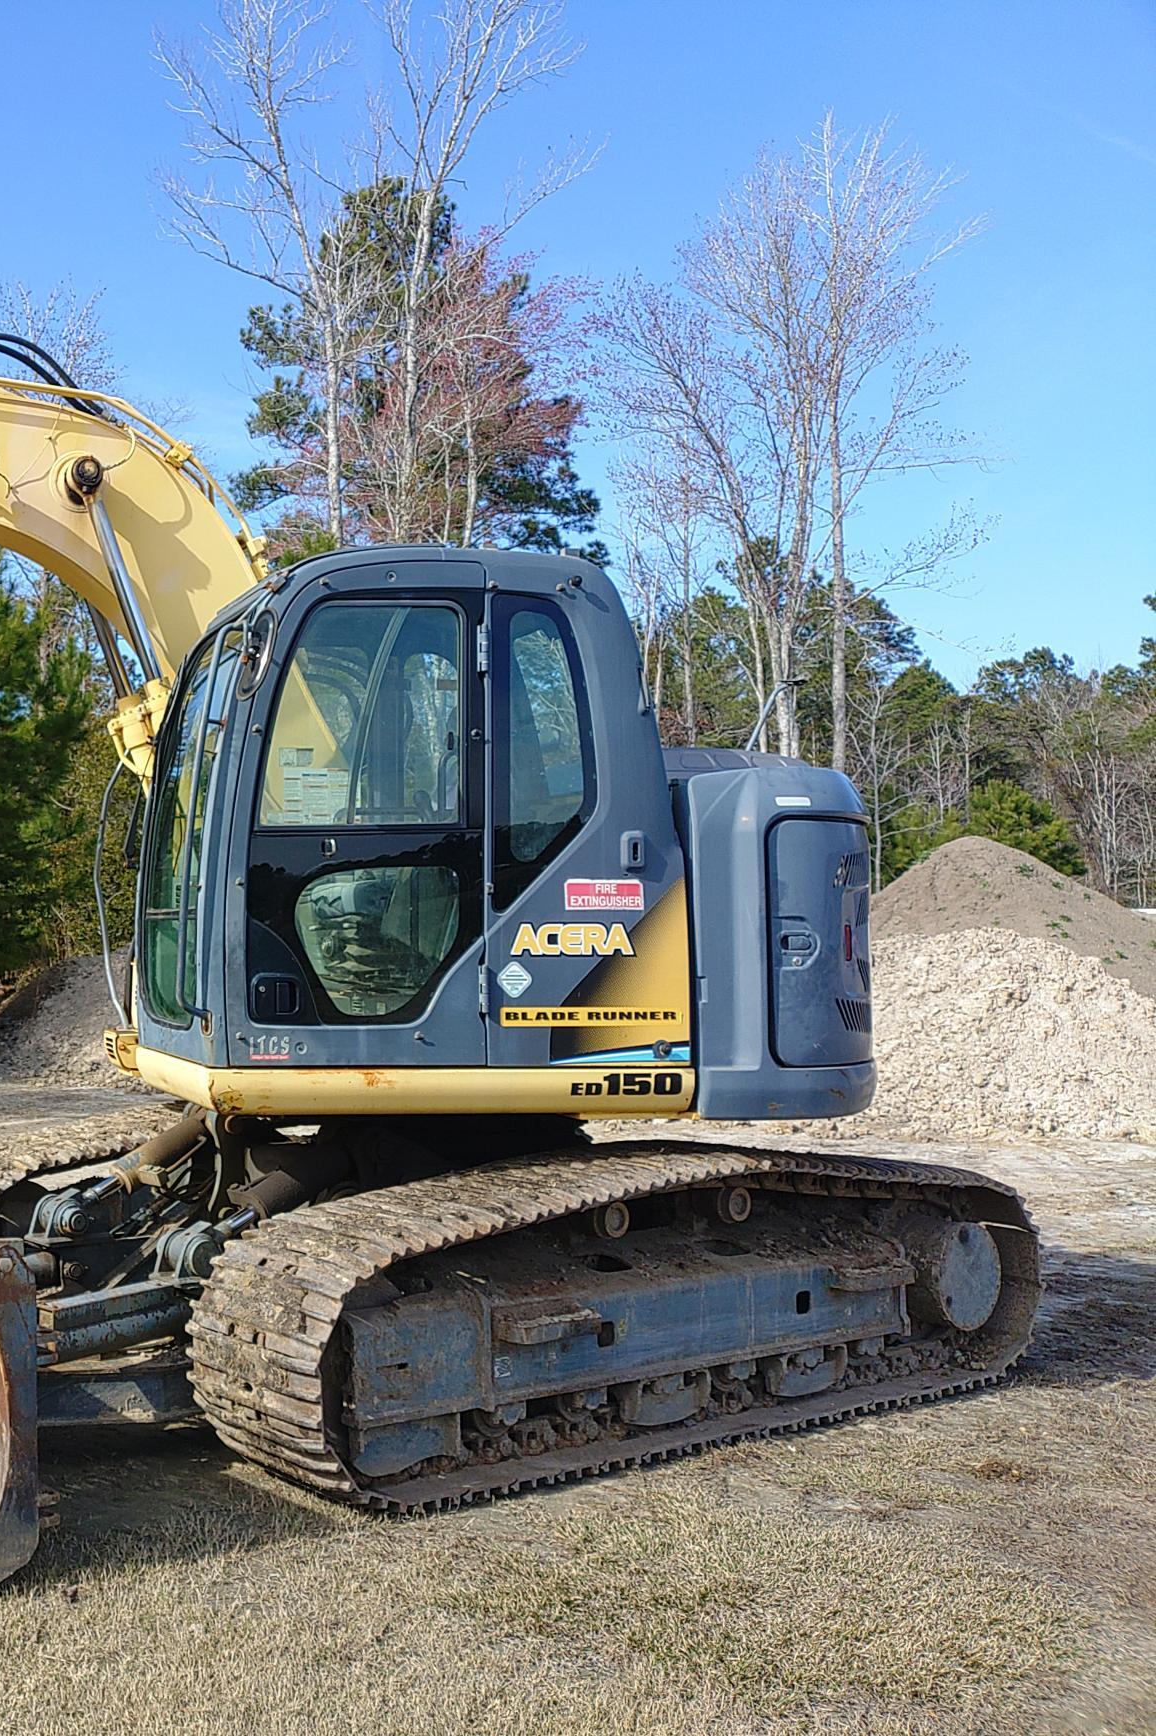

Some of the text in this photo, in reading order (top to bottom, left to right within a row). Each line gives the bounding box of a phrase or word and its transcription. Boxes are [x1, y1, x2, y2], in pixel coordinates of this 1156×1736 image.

[595, 884, 617, 894] FIRE
[570, 895, 642, 907] EXTINGUISHER
[511, 922, 636, 957] ACERA
[505, 1011, 676, 1021] BLADE RUNNER
